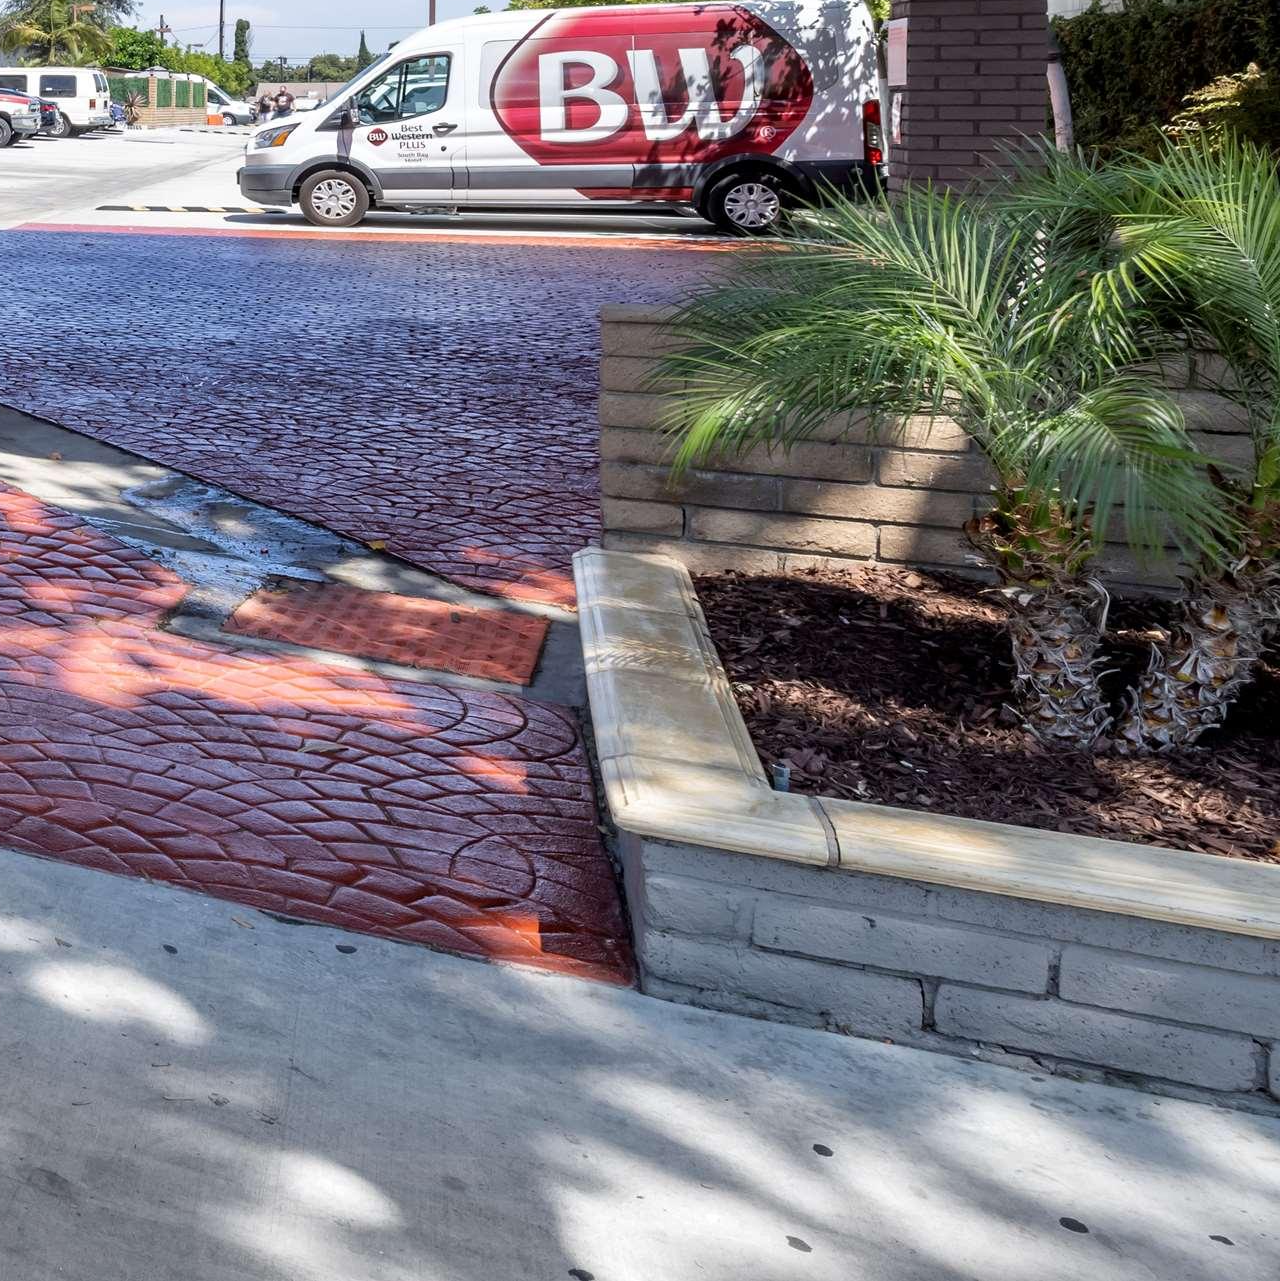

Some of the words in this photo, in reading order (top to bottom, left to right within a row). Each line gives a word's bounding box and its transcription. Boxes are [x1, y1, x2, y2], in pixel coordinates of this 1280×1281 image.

[538, 44, 765, 142] BW
[401, 124, 423, 132] Best
[369, 133, 386, 142] BW
[399, 141, 426, 149] PLUS
